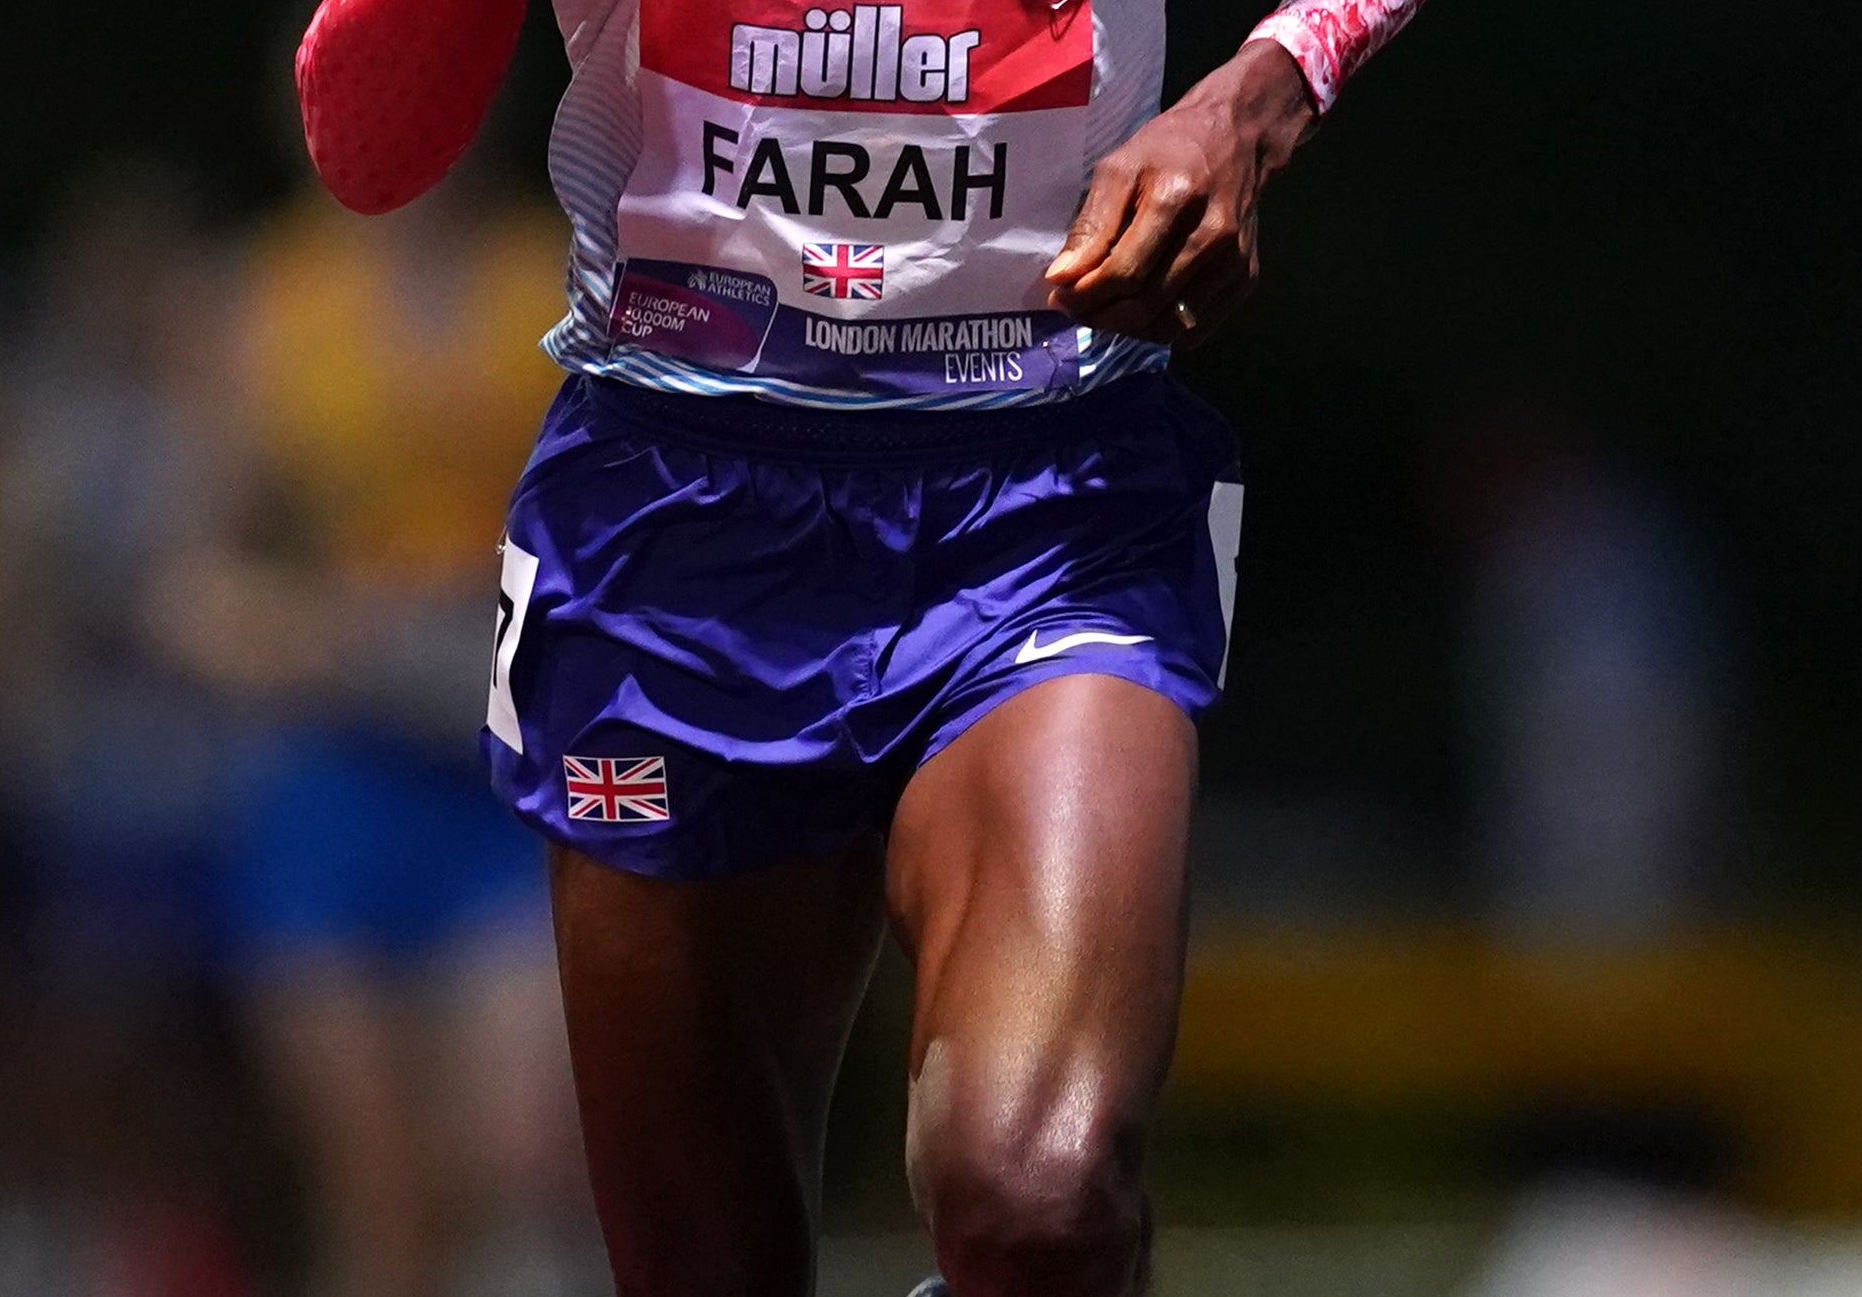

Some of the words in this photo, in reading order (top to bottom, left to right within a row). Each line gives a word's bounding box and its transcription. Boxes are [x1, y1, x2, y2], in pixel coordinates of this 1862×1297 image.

[729, 4, 980, 102] müller
[701, 120, 1008, 221] FARAH
[708, 284, 770, 306] ATHLETICS
[709, 271, 771, 296] EUROPEAN
[629, 291, 710, 322] EUROPEAN
[622, 320, 653, 338] CUP
[805, 317, 897, 355] LONDON
[901, 317, 1032, 353] MARATHON
[945, 351, 1023, 384] EVENTS
